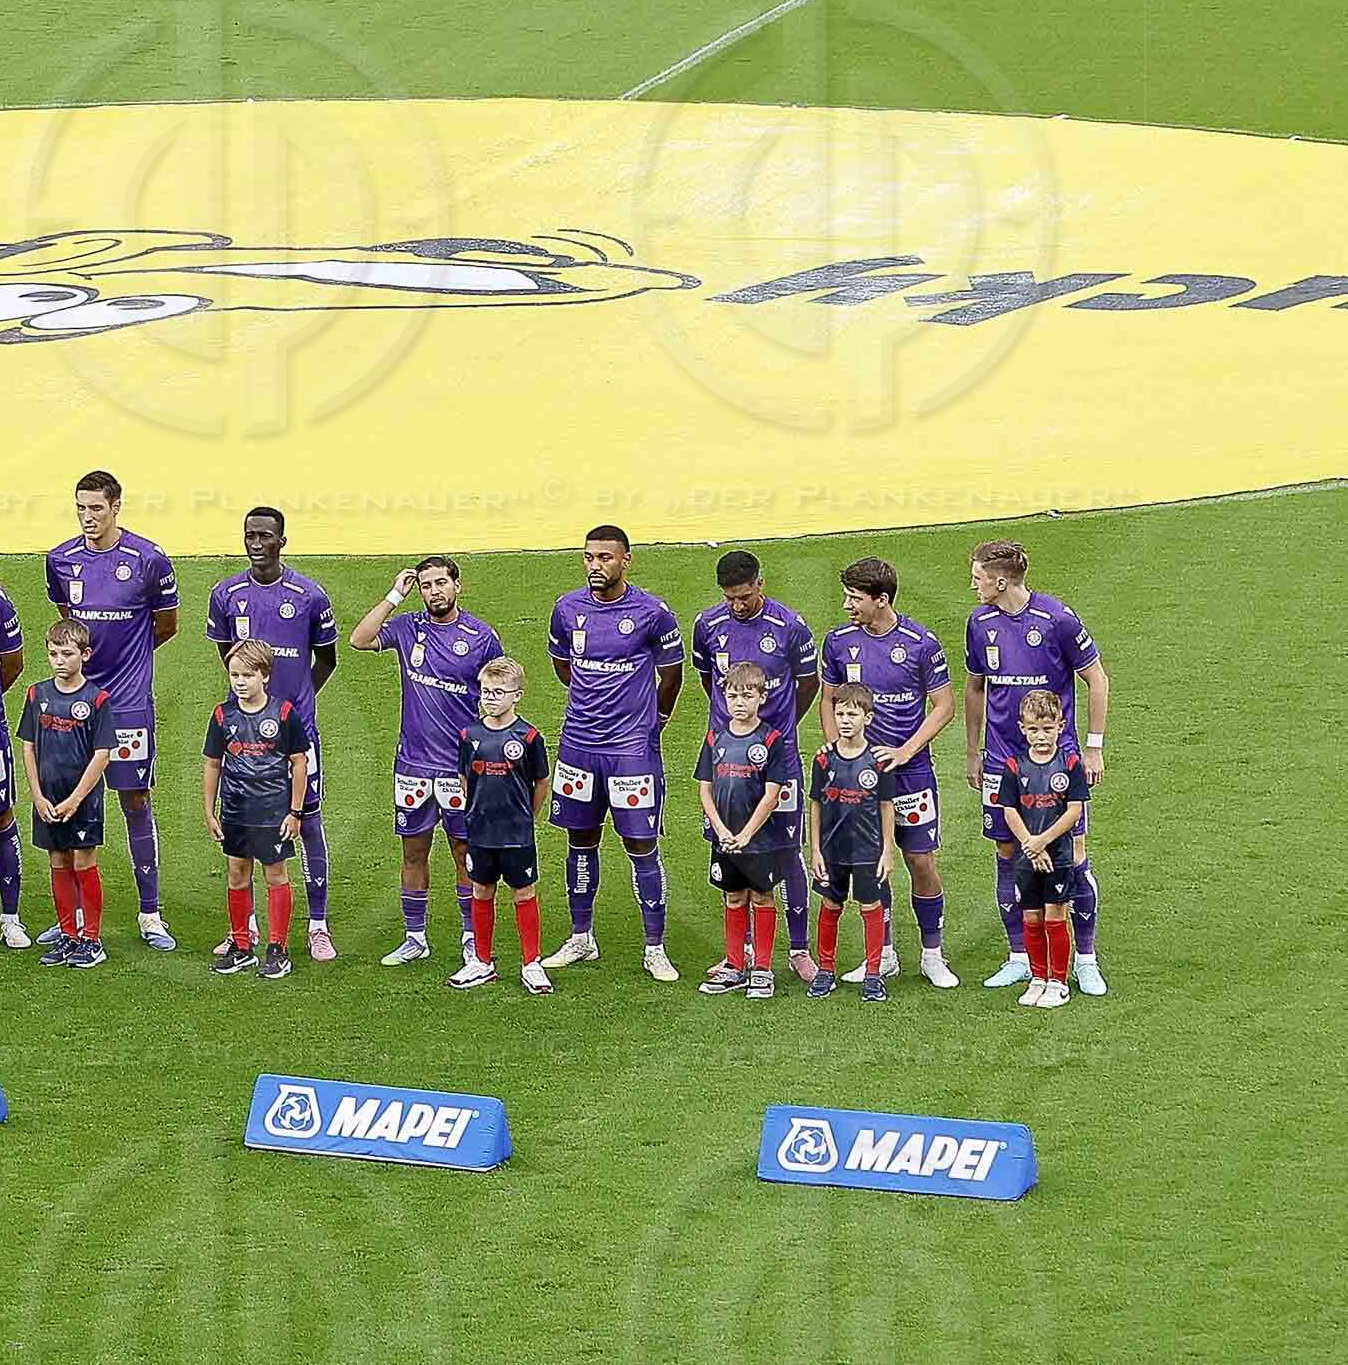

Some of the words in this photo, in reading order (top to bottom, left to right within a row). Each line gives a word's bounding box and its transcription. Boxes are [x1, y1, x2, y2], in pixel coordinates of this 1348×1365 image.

[704, 254, 1348, 326] ucky
[327, 1097, 471, 1149] MAPEI
[845, 1128, 1001, 1180] MAPEI
